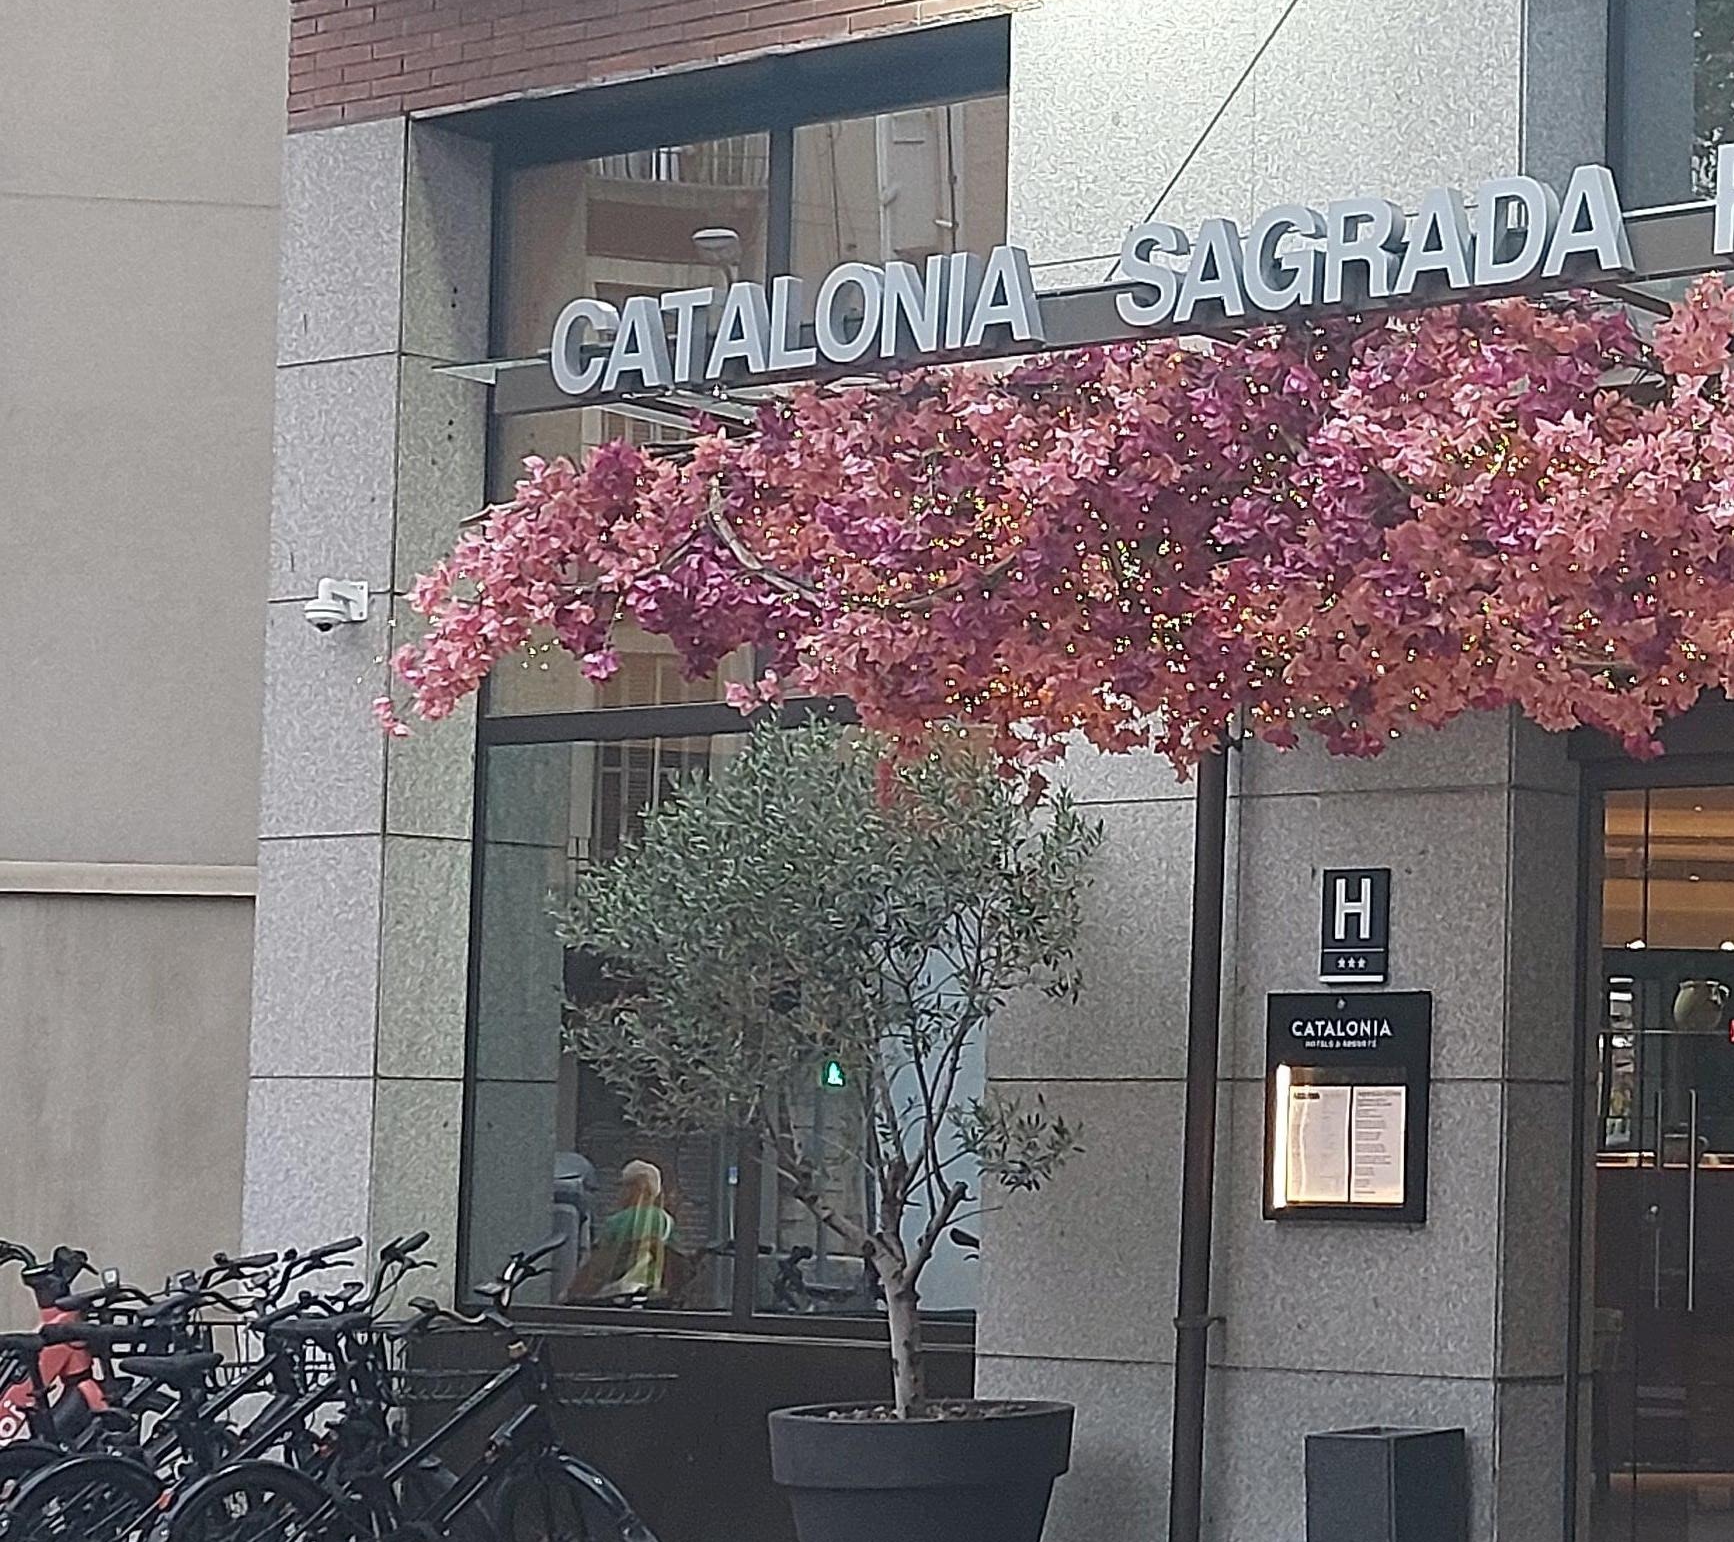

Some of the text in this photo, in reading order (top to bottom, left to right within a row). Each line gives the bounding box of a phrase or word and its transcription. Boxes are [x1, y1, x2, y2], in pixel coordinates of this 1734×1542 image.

[550, 245, 1046, 396] CATALONIA
[1116, 165, 1636, 328] SAGRADA
[1334, 877, 1372, 940] H
[1291, 1019, 1393, 1037] CATALONIA
